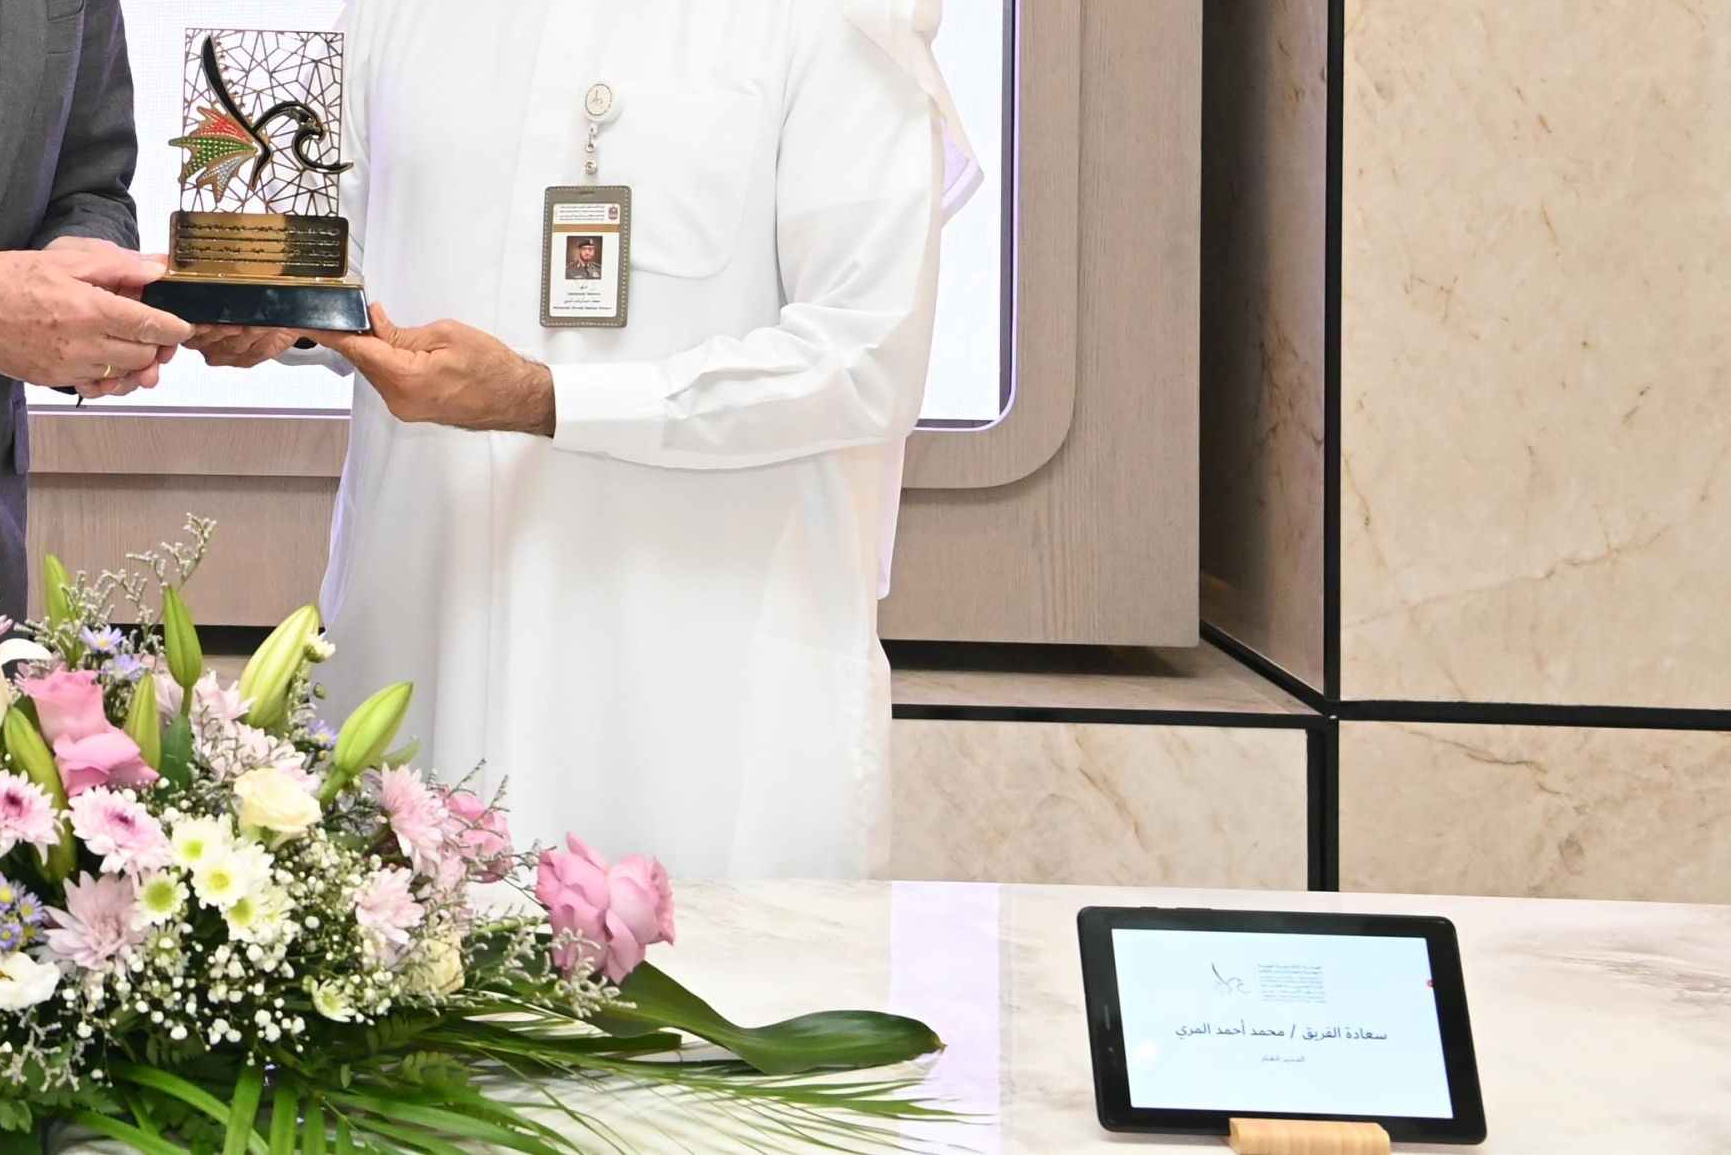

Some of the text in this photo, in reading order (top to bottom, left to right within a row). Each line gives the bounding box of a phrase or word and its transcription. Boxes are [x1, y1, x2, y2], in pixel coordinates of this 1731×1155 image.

[1175, 1023, 1211, 1040] المري
[1215, 1019, 1245, 1035] أحمد
[1250, 1026, 1285, 1037] محمد
[1302, 1026, 1341, 1041] الفريق
[1345, 1027, 1388, 1041] سعادة
